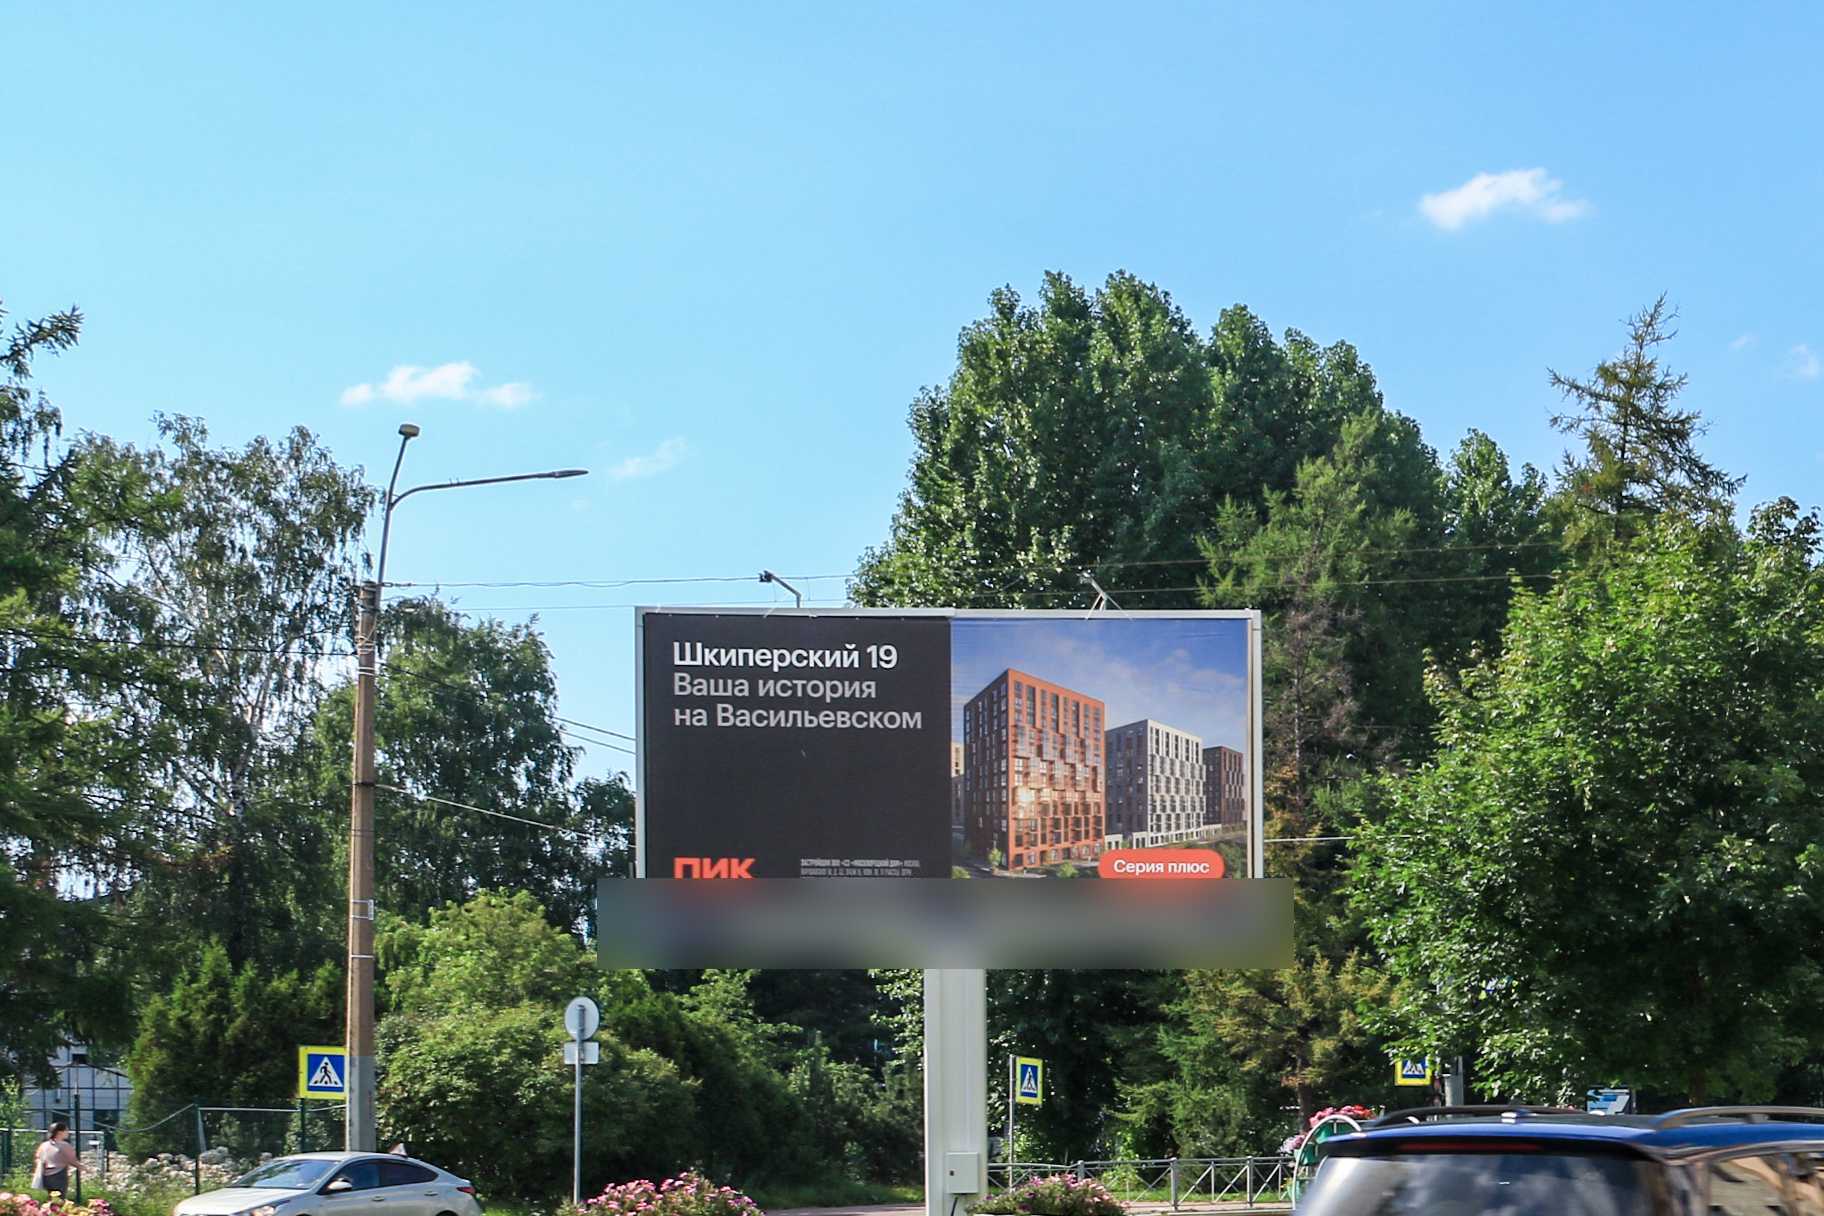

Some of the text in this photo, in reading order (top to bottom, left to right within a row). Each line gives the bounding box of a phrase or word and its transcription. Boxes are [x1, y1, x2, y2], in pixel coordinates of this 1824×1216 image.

[673, 642, 898, 672] Шкиперский 19
[673, 672, 877, 703] Ваша история
[673, 703, 923, 729] на Васильевском
[674, 857, 756, 879] ПИК
[1113, 860, 1210, 876] Серия плюс
